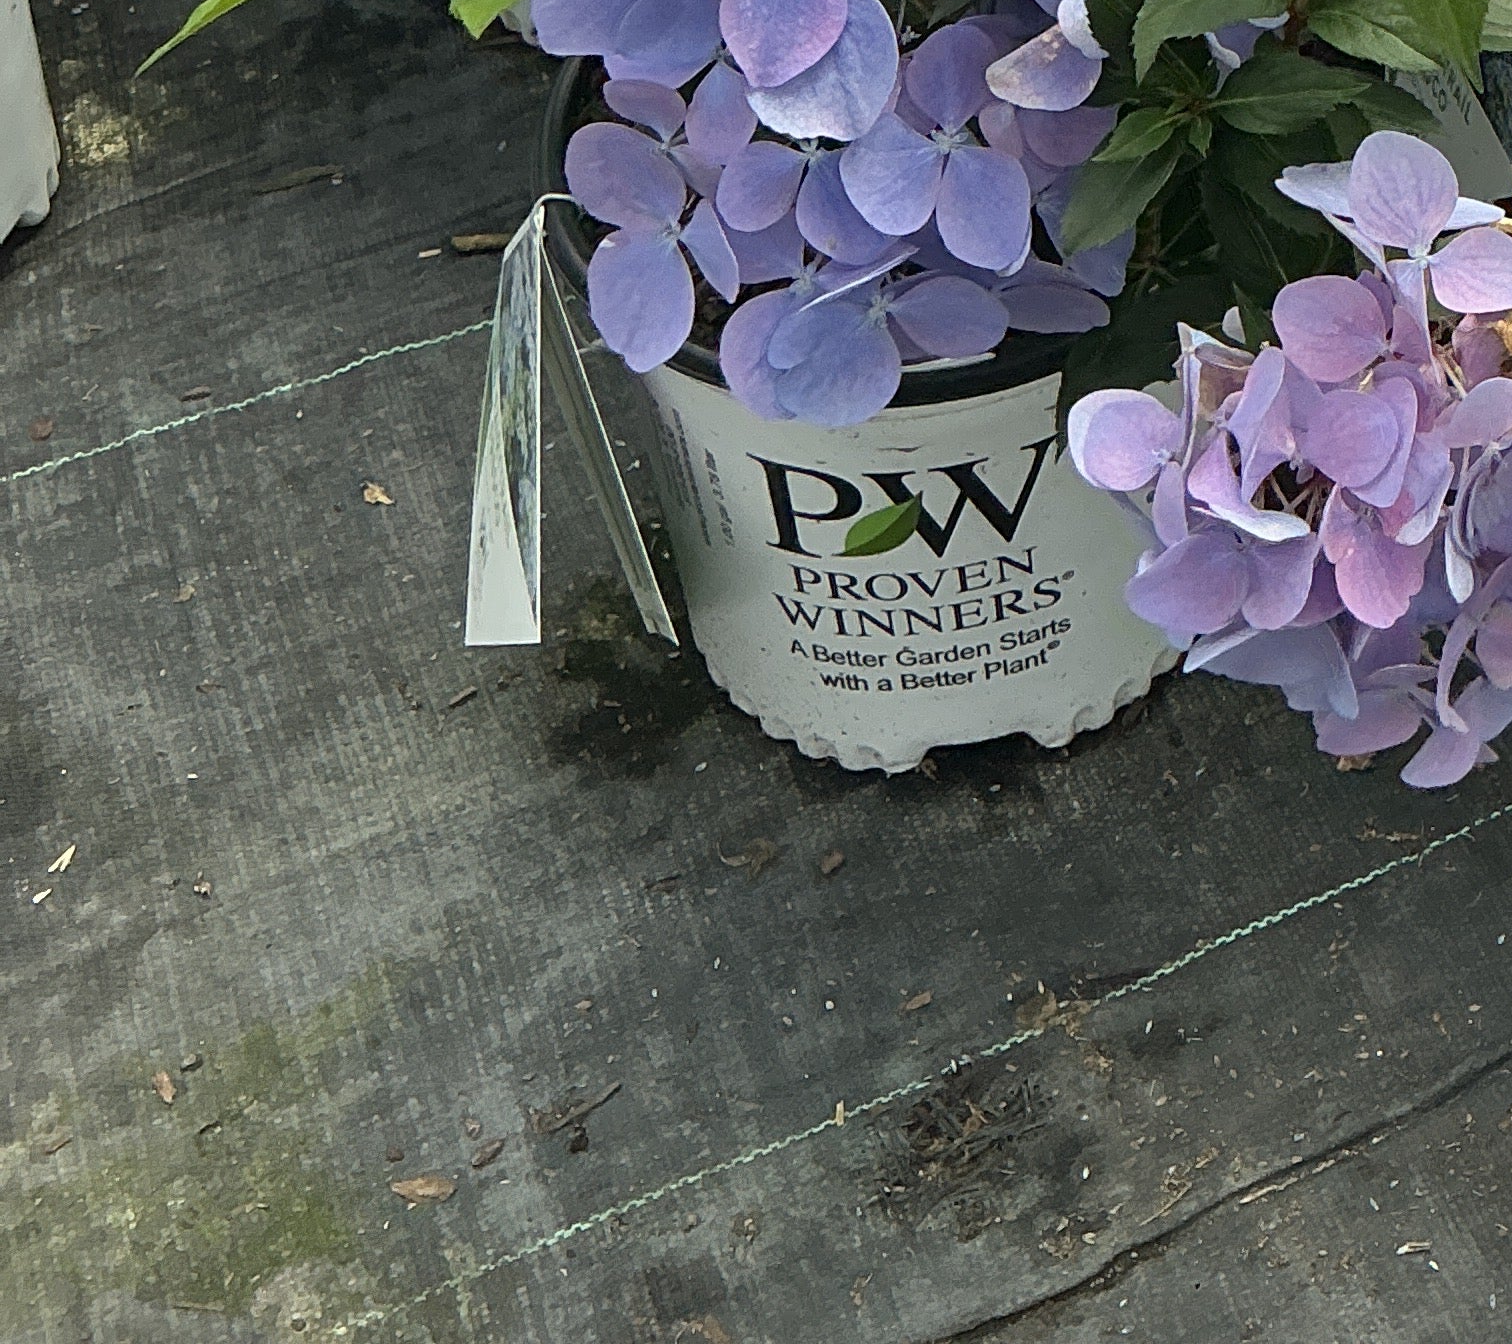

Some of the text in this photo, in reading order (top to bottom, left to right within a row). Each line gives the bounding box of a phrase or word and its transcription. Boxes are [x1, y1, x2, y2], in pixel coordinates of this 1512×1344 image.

[745, 431, 1060, 559] PW
[788, 545, 1038, 602] PROVEN
[790, 616, 1073, 668] A Better Garden Starts
[819, 671, 869, 692] with
[876, 678, 894, 692] a
[900, 667, 978, 691] Better
